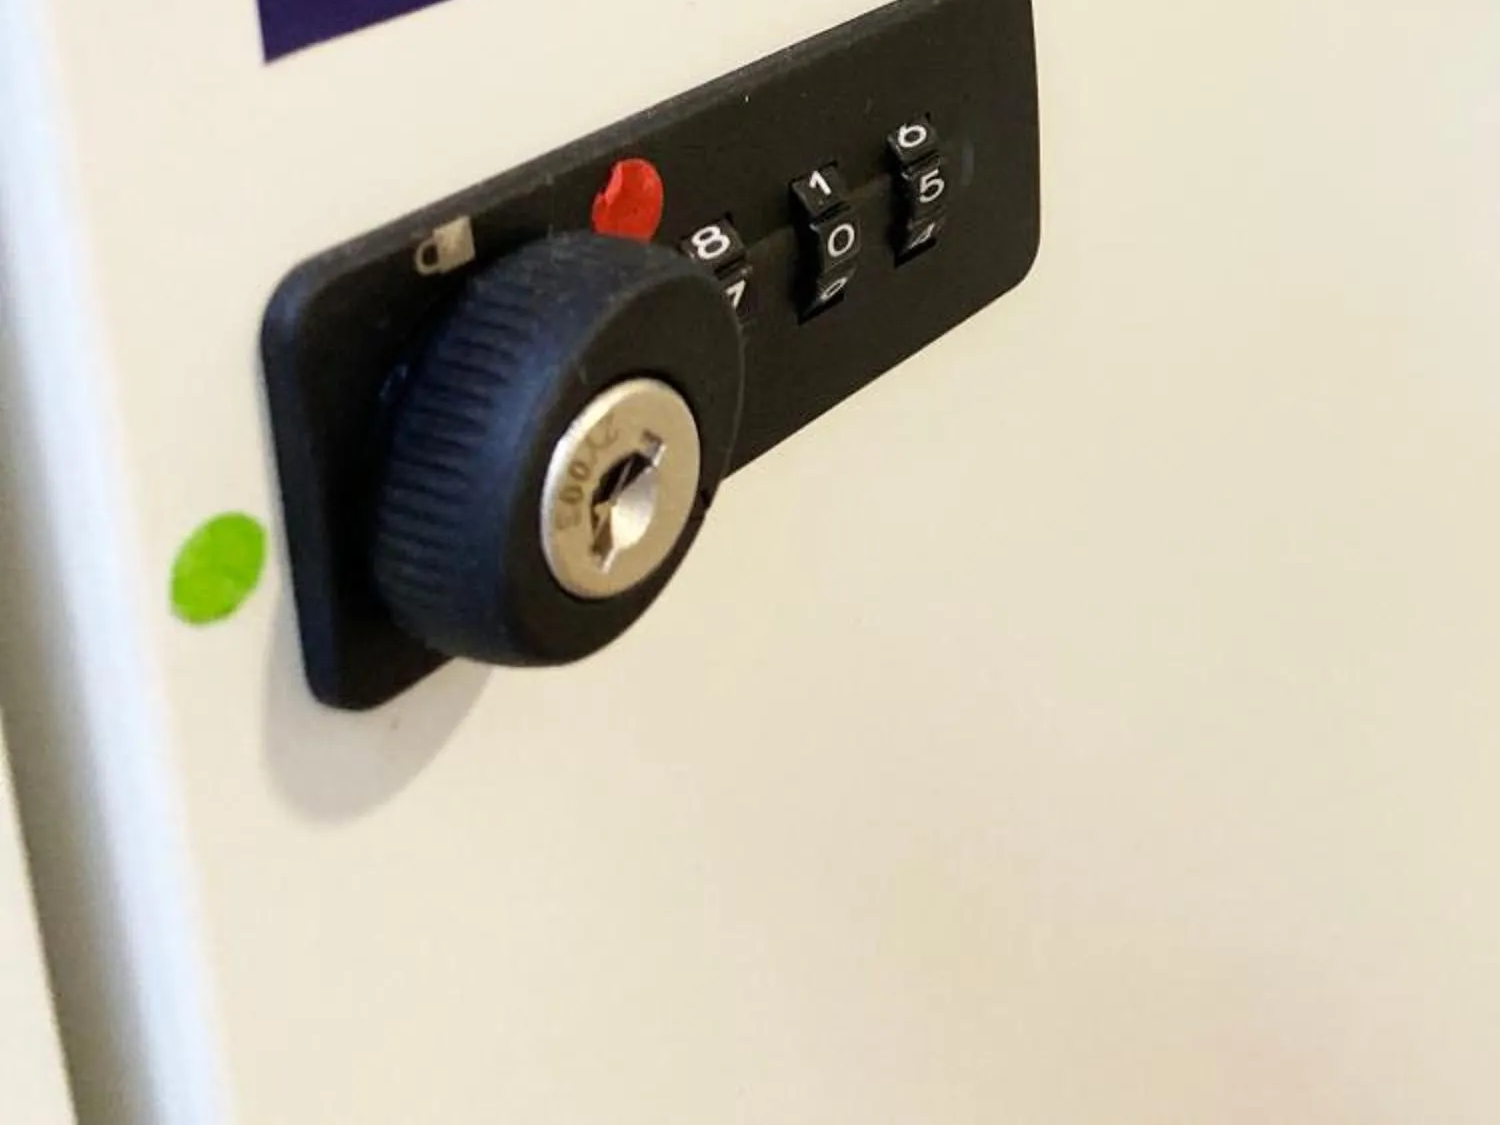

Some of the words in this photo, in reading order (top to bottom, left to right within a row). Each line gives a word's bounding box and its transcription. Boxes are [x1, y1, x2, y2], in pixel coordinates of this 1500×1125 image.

[809, 170, 831, 196] 1
[919, 170, 945, 203] 5
[691, 225, 730, 260] 8
